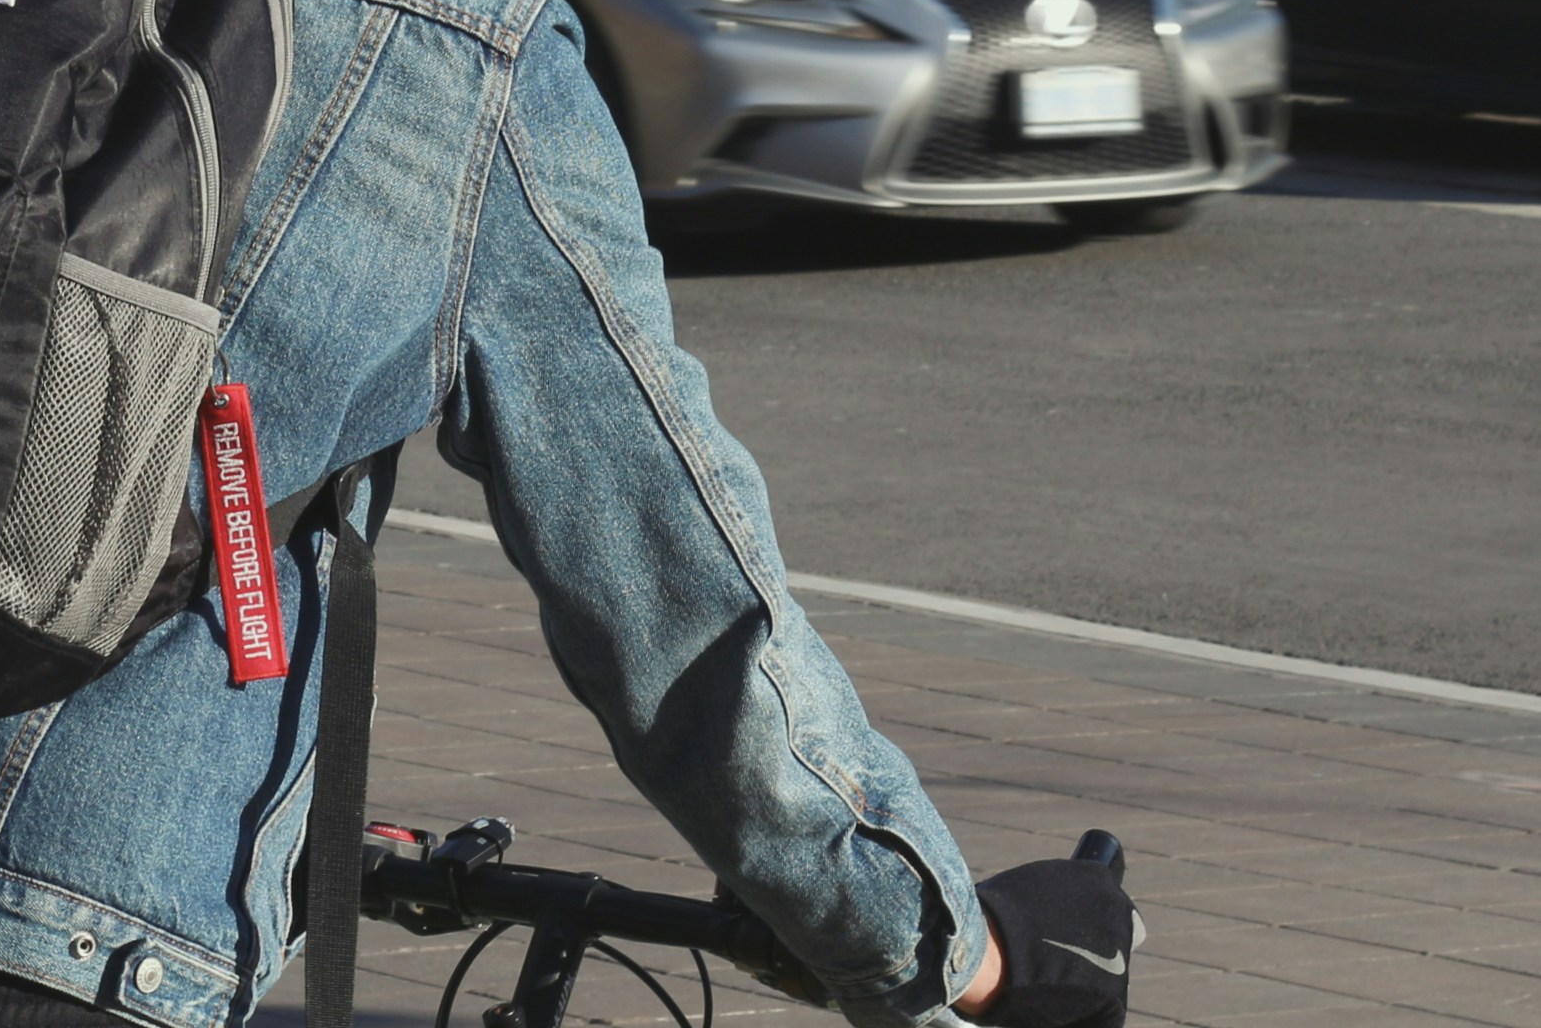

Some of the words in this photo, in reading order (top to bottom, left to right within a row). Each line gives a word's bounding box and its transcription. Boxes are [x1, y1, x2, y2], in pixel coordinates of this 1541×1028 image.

[213, 421, 250, 509] REMOVE
[225, 509, 262, 590] BEFORE
[236, 589, 272, 661] FLIGHT
